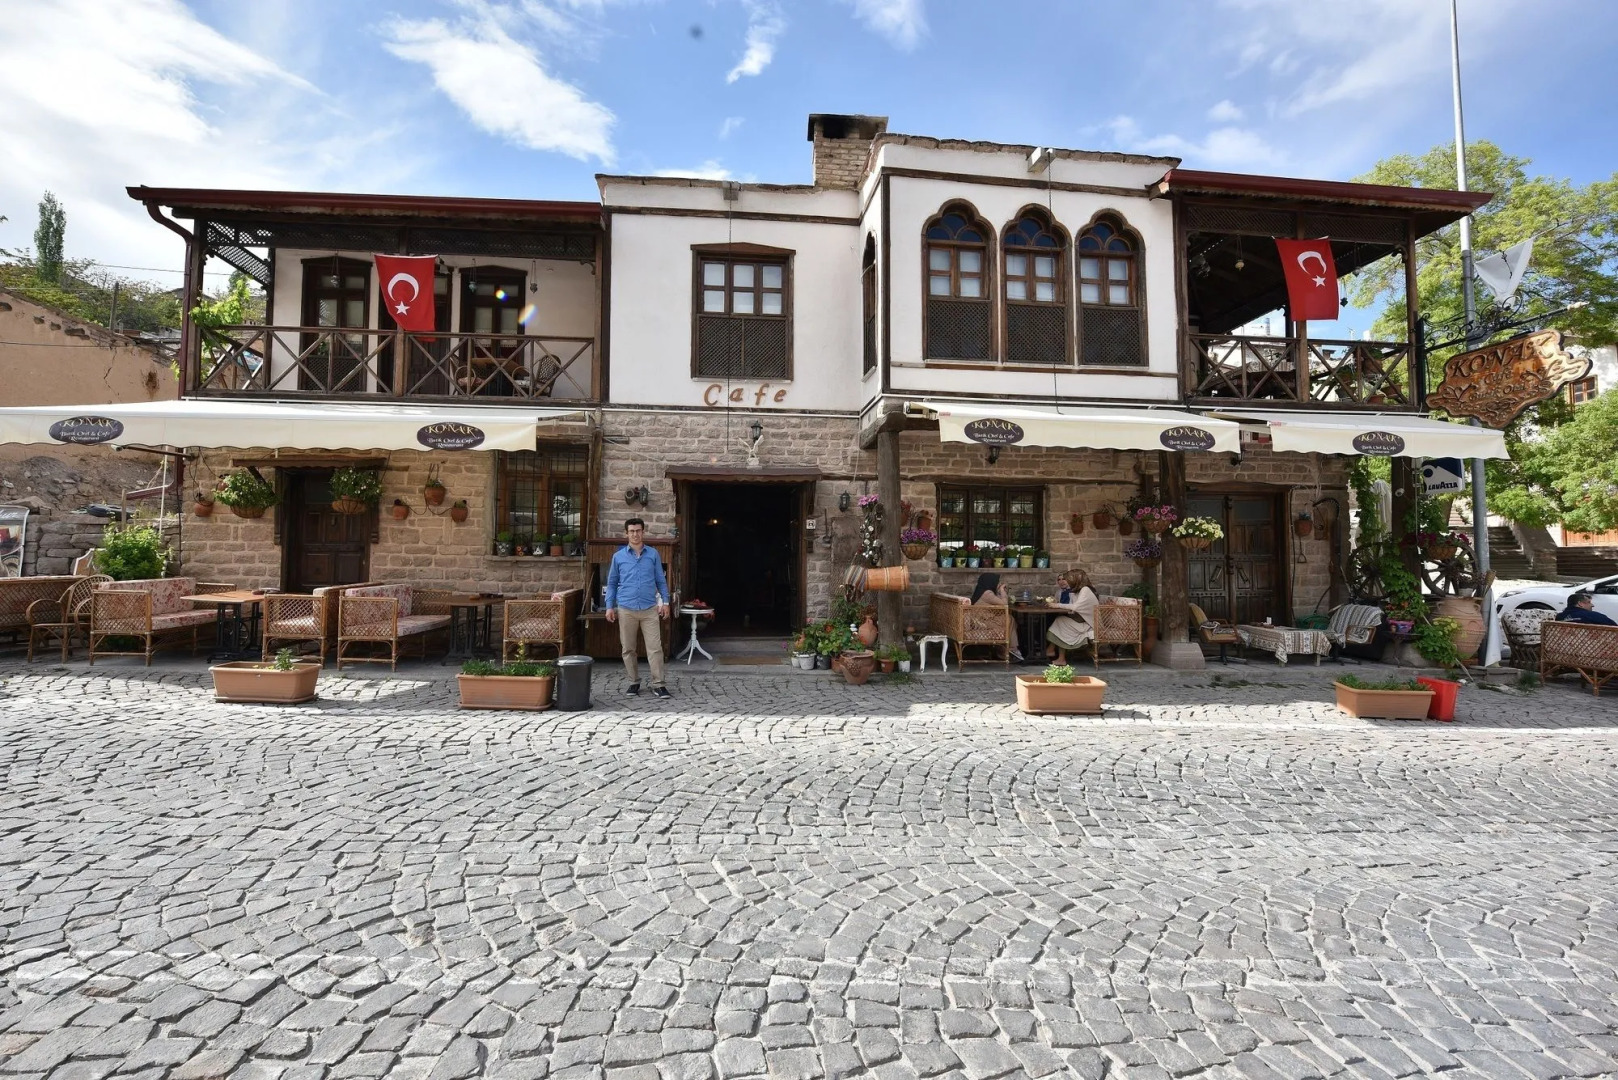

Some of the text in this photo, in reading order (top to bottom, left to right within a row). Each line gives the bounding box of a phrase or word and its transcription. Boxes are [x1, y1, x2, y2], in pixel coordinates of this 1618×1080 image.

[1449, 335, 1553, 377] KONAK
[704, 383, 787, 406] Cafe
[60, 417, 118, 432] KONAK
[425, 424, 480, 439] KONAK
[971, 419, 1019, 435] KONAK
[1166, 427, 1211, 442] KONAK
[1359, 432, 1401, 446] KONAK
[1428, 481, 1458, 490] LAVAZZA
